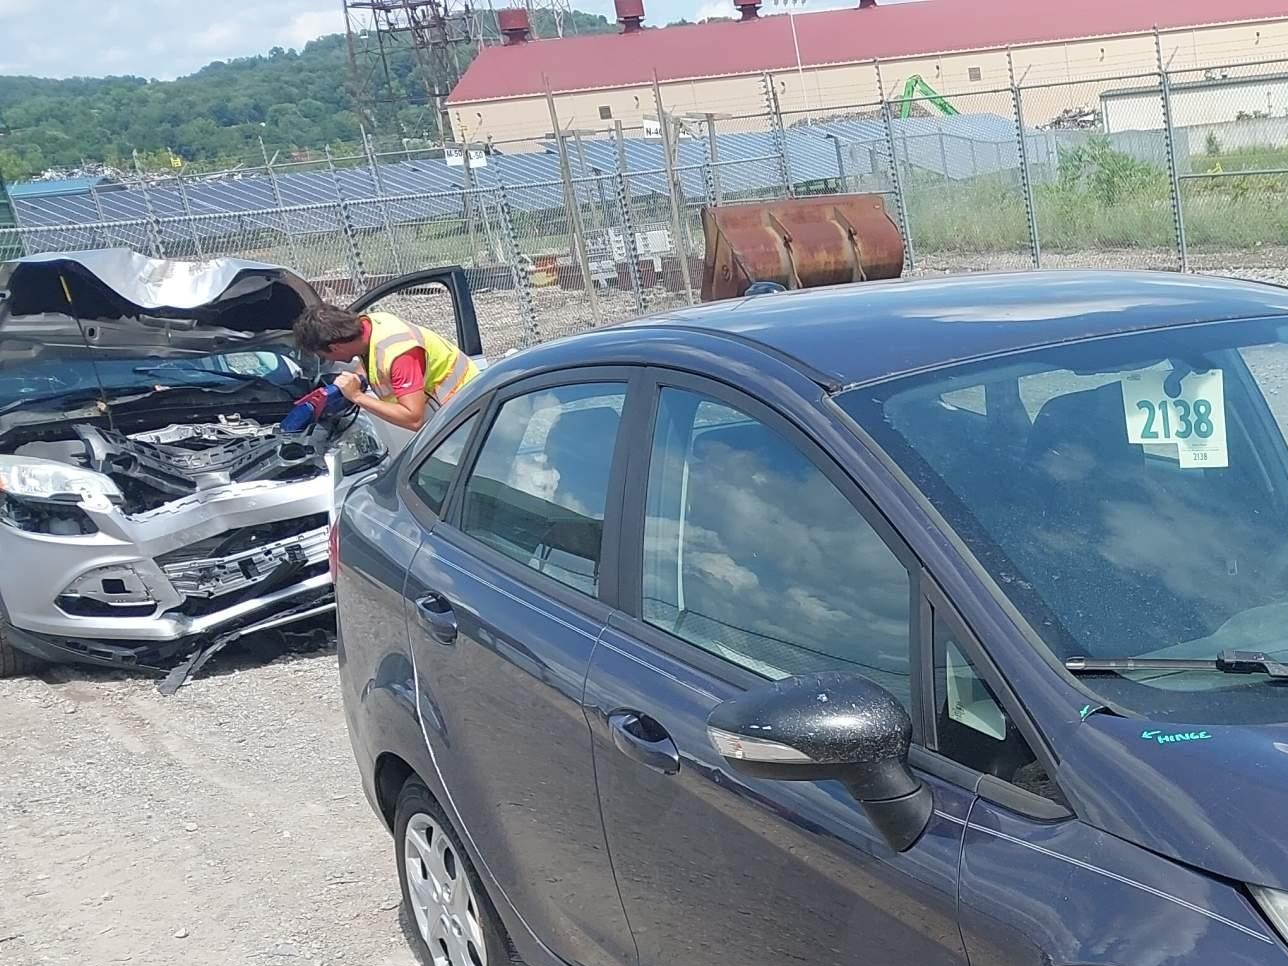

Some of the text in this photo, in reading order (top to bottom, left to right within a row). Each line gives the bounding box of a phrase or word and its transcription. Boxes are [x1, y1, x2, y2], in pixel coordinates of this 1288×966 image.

[1135, 398, 1215, 440] 2138
[1192, 452, 1208, 461] 2138
[1156, 730, 1213, 744] HINGE
